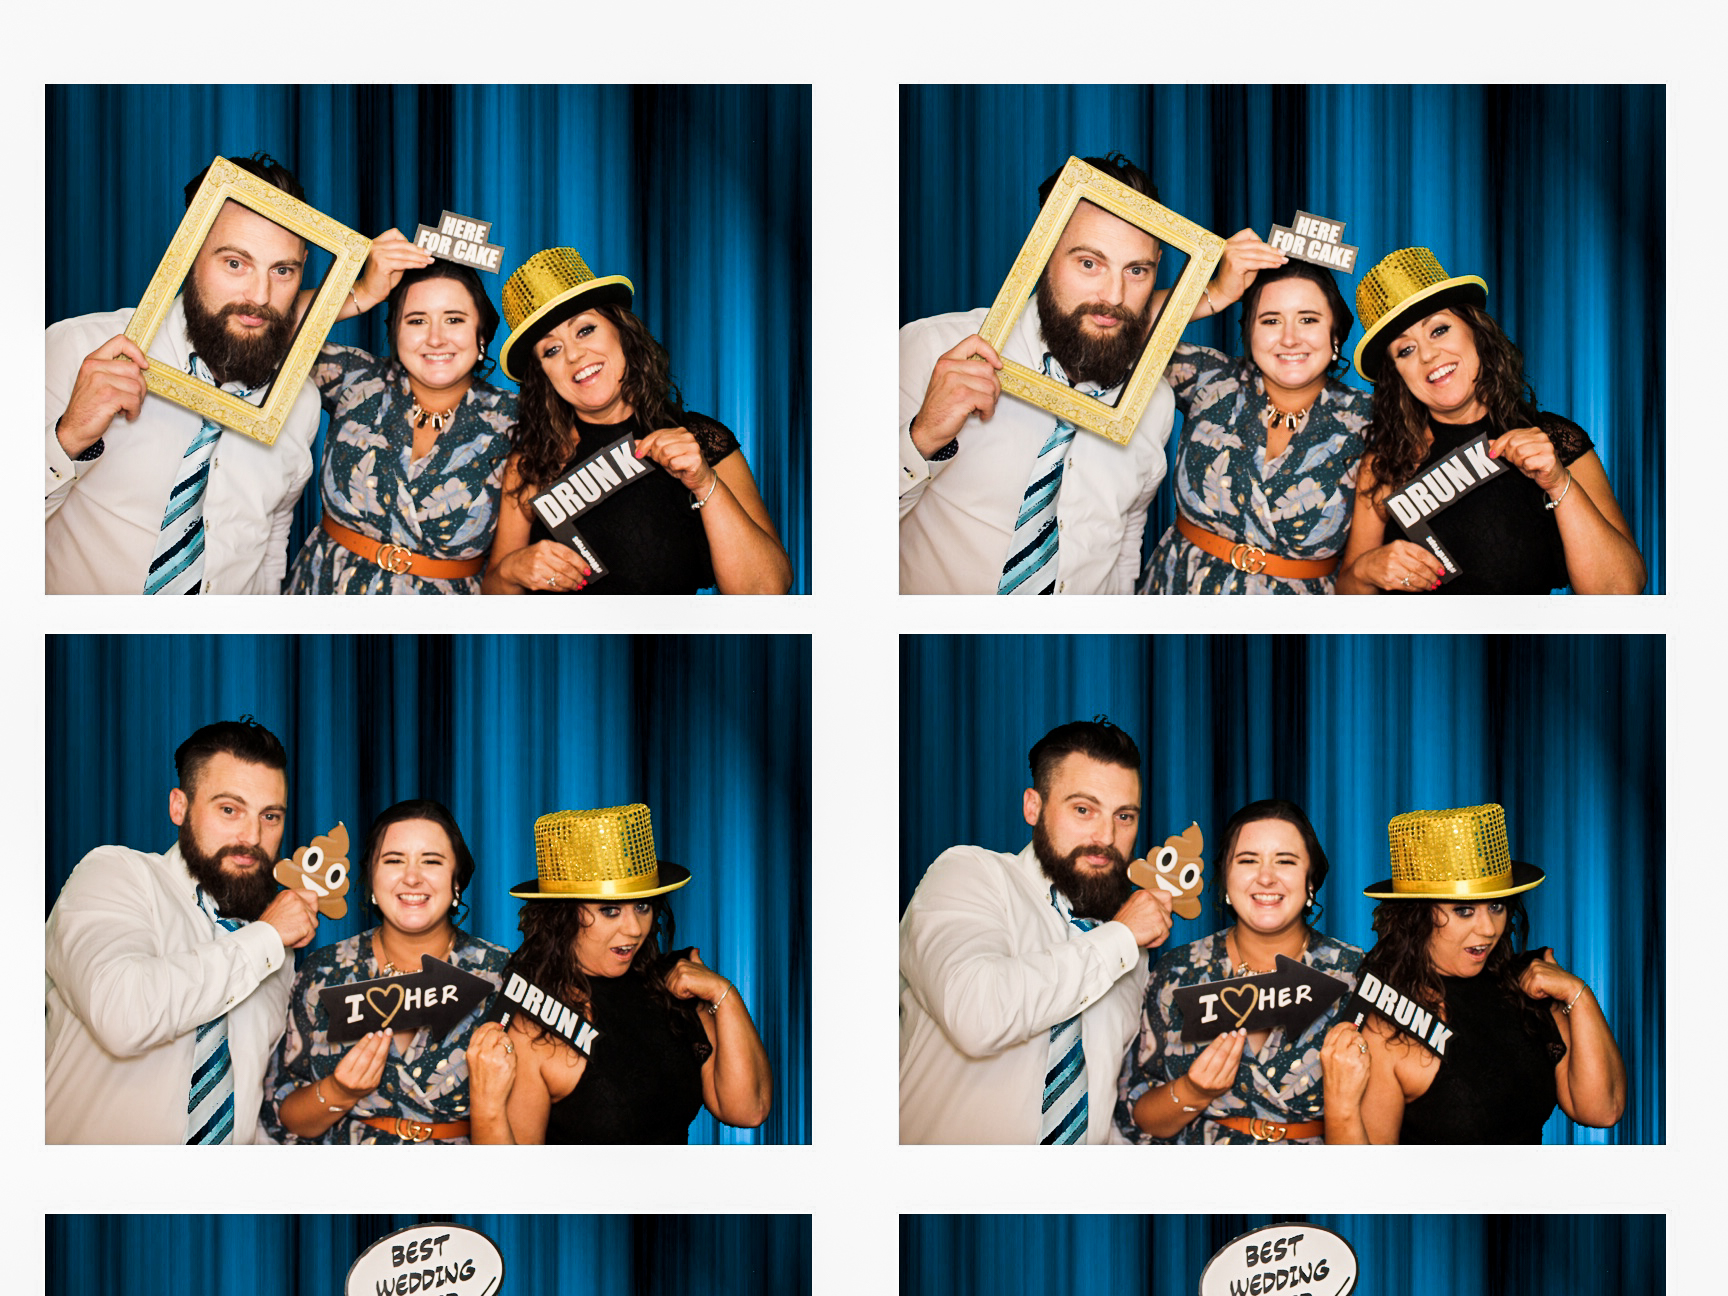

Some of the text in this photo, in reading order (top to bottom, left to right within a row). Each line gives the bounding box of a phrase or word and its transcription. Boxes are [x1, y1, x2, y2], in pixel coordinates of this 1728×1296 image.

[441, 216, 486, 244] HERE
[1295, 216, 1340, 244] HERE
[417, 229, 500, 269] FOR CAKE
[1271, 229, 1354, 269] FOR CAKE
[344, 984, 459, 1024] I HER
[1198, 984, 1313, 1024] I HER
[392, 1233, 450, 1268] BEST
[1246, 1233, 1304, 1268] BEST
